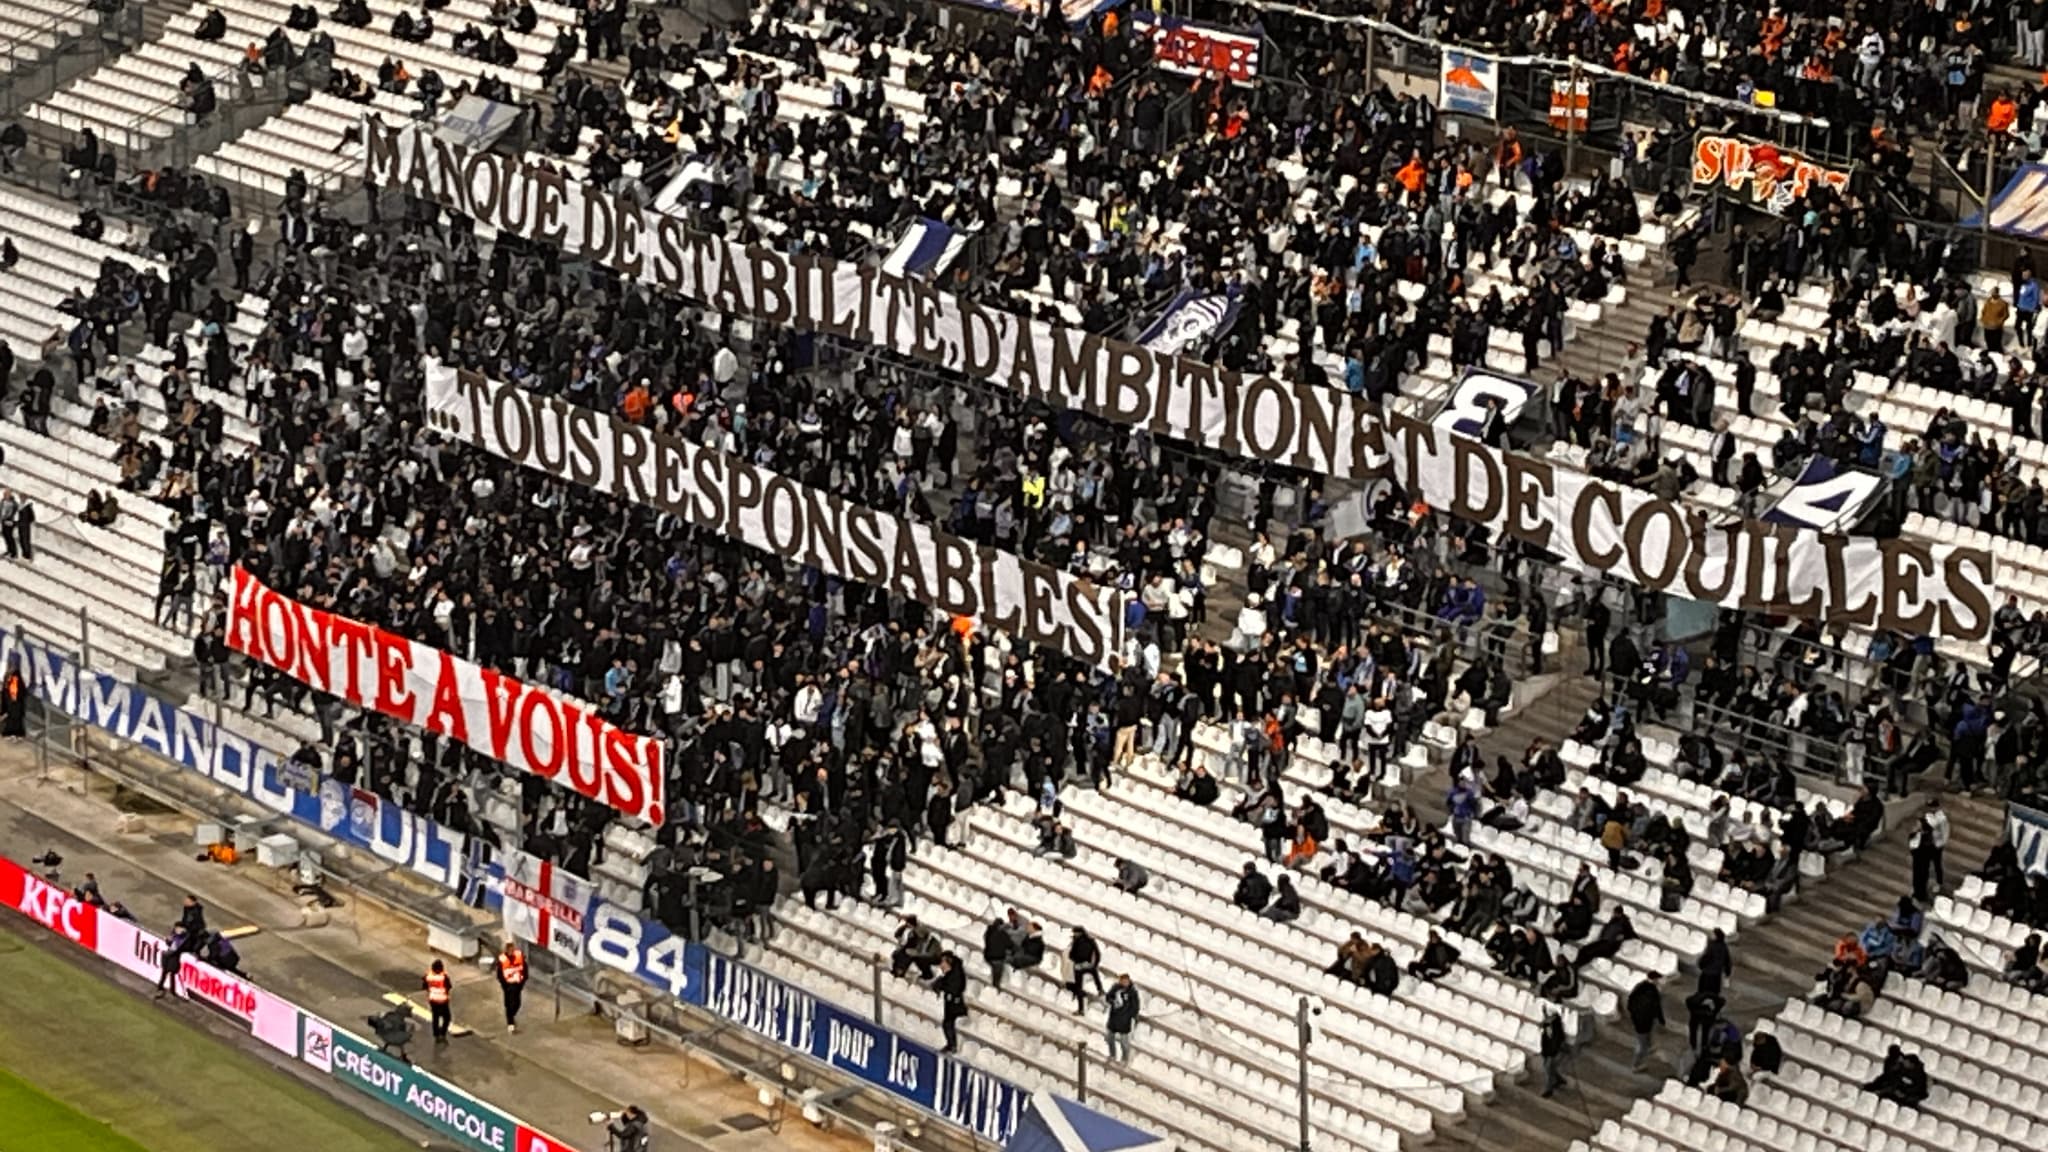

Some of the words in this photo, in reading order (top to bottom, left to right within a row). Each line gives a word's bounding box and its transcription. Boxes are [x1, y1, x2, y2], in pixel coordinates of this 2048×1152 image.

[366, 117, 568, 243] MANQUE
[581, 186, 645, 276] DE
[958, 301, 1341, 474] D'AMBITION
[1350, 400, 1437, 500] ET
[1450, 437, 1554, 546] DE
[1571, 481, 1994, 640] COUILLES
[609, 413, 1121, 675] RESPONSABLES!
[228, 566, 416, 721] HONTE
[426, 650, 470, 742] A
[481, 669, 662, 826] VOUS!
[20, 873, 83, 941] KFC
[588, 902, 688, 996] 84
[332, 1045, 404, 1096] CRÉDIT
[405, 1084, 505, 1152] AGRICOLE
[827, 1017, 875, 1066] pour
[887, 1033, 920, 1092] les
[934, 1053, 1030, 1148] ULTRA
